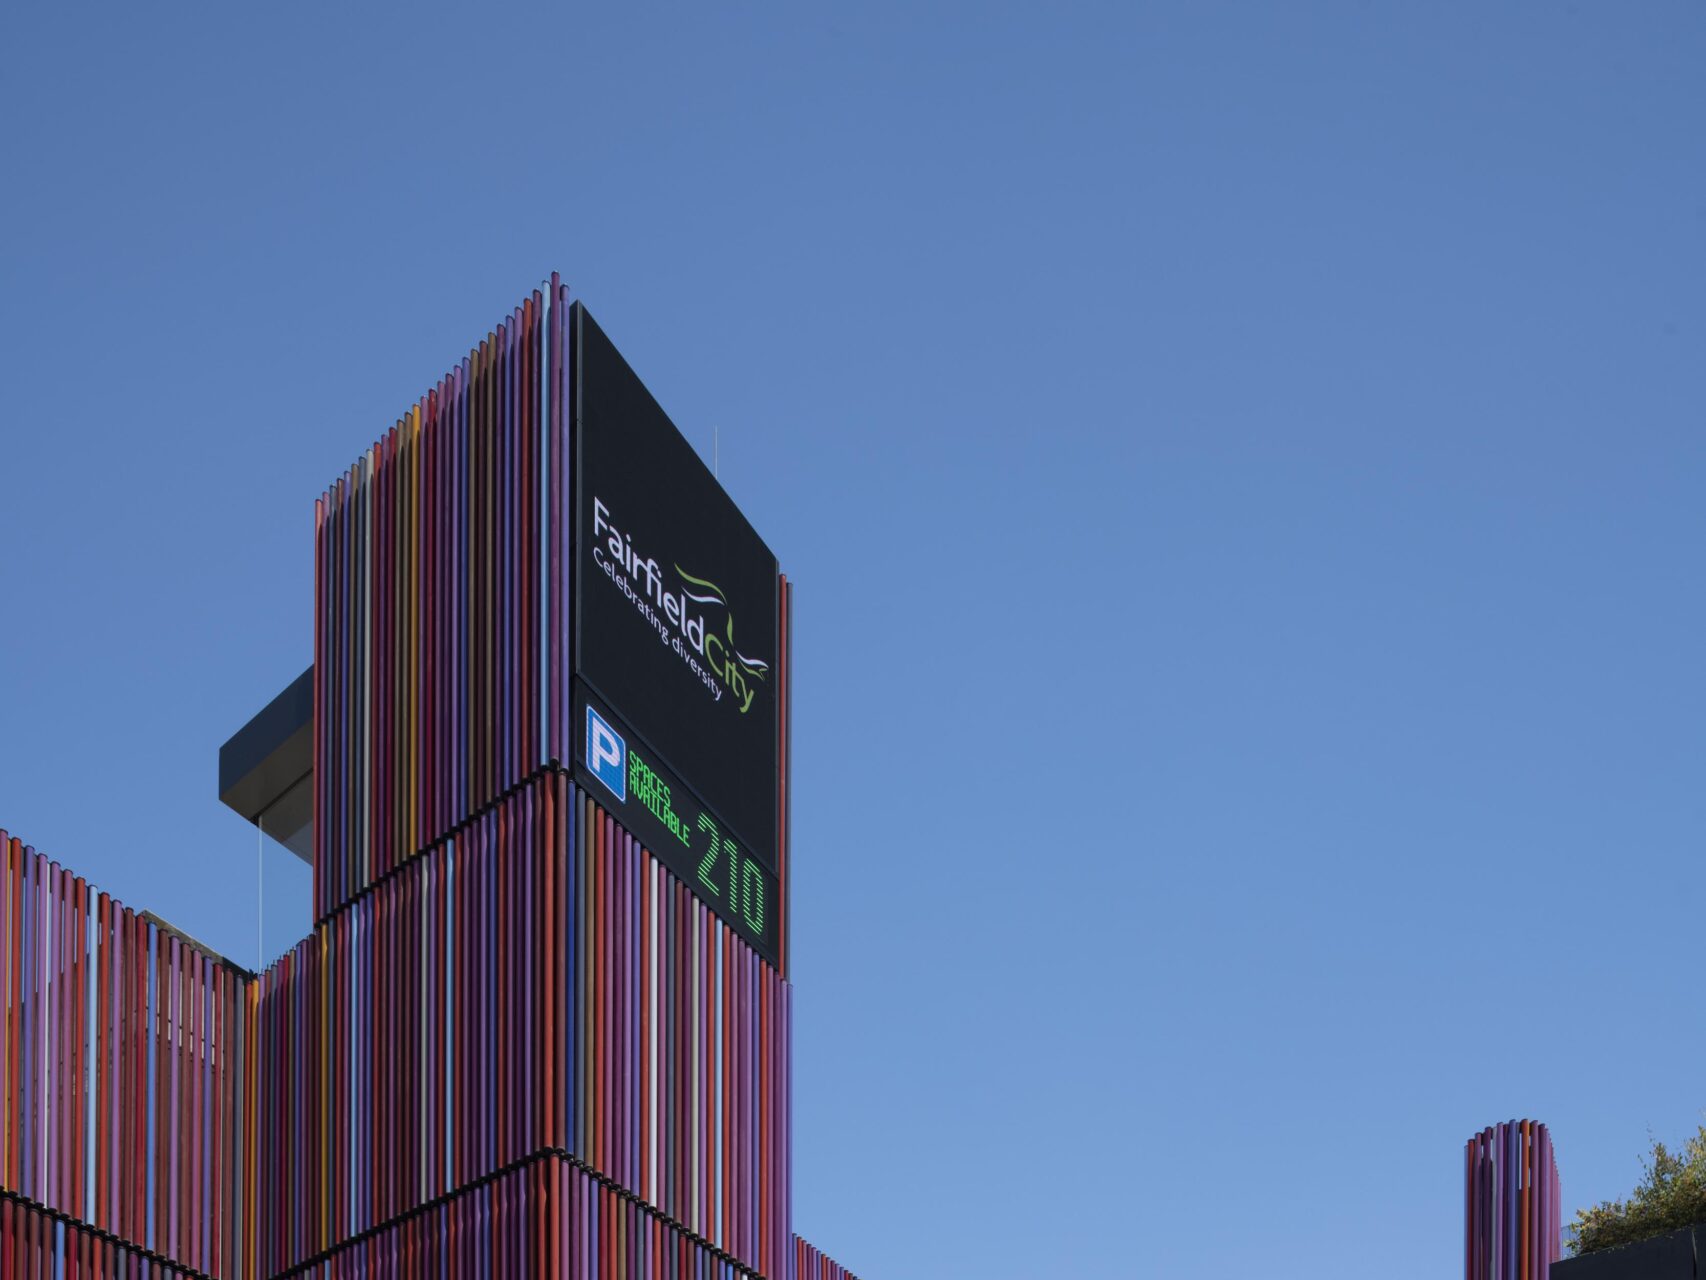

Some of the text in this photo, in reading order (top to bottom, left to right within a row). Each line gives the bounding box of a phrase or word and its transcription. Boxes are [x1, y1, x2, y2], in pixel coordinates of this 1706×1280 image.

[593, 547, 722, 701] Celebrating diversity
[592, 717, 620, 772] P
[629, 750, 671, 808] SPACES
[629, 771, 690, 848] AVAILABLE
[698, 812, 763, 935] 210
